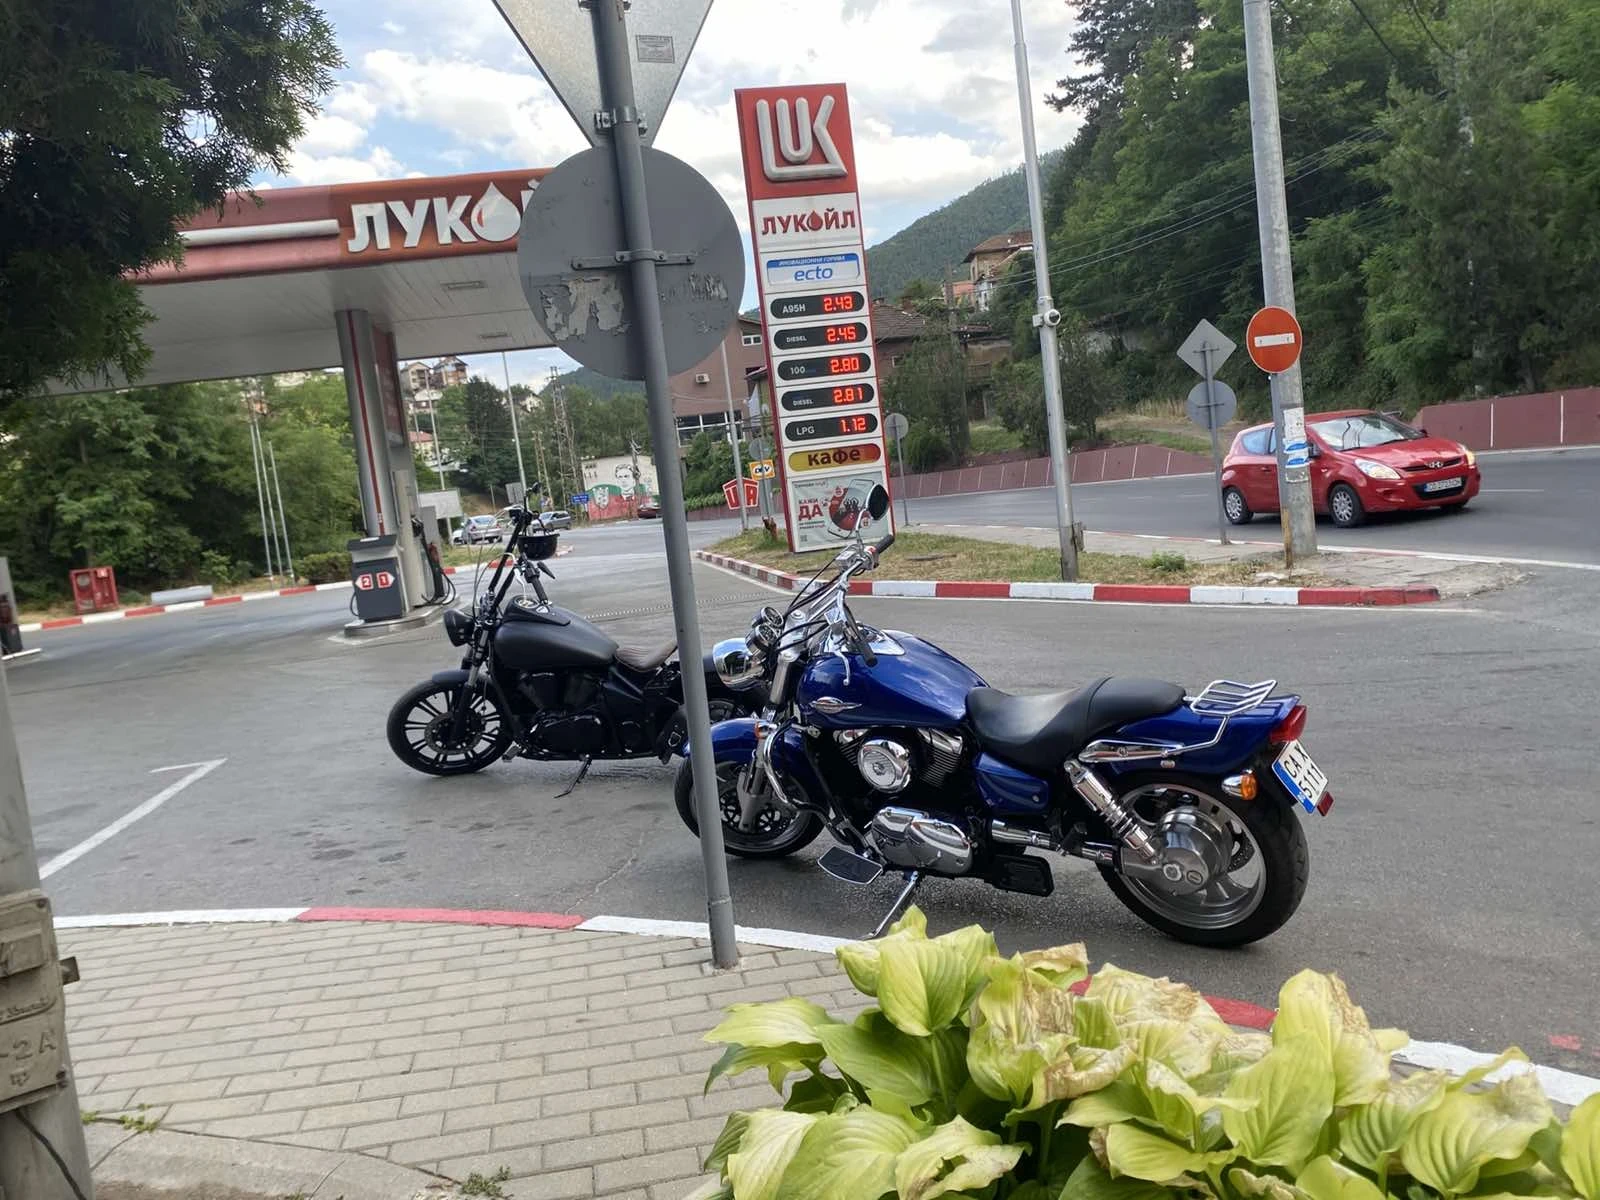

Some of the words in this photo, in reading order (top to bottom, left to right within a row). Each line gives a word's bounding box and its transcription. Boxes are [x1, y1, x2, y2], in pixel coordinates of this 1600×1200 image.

[761, 208, 856, 235] ЛУКОЙЛ
[794, 266, 833, 281] ecto
[824, 296, 853, 311] 2.43
[786, 335, 807, 343] DIESEL
[827, 326, 856, 342] 2.45
[790, 366, 806, 375] 100
[830, 357, 859, 373] 2.80
[833, 387, 863, 403] 2.81
[796, 426, 815, 436] LPG
[841, 417, 866, 433] 1.12
[798, 503, 824, 521] ДА
[362, 576, 371, 588] 2
[1298, 763, 1323, 799] 5111
